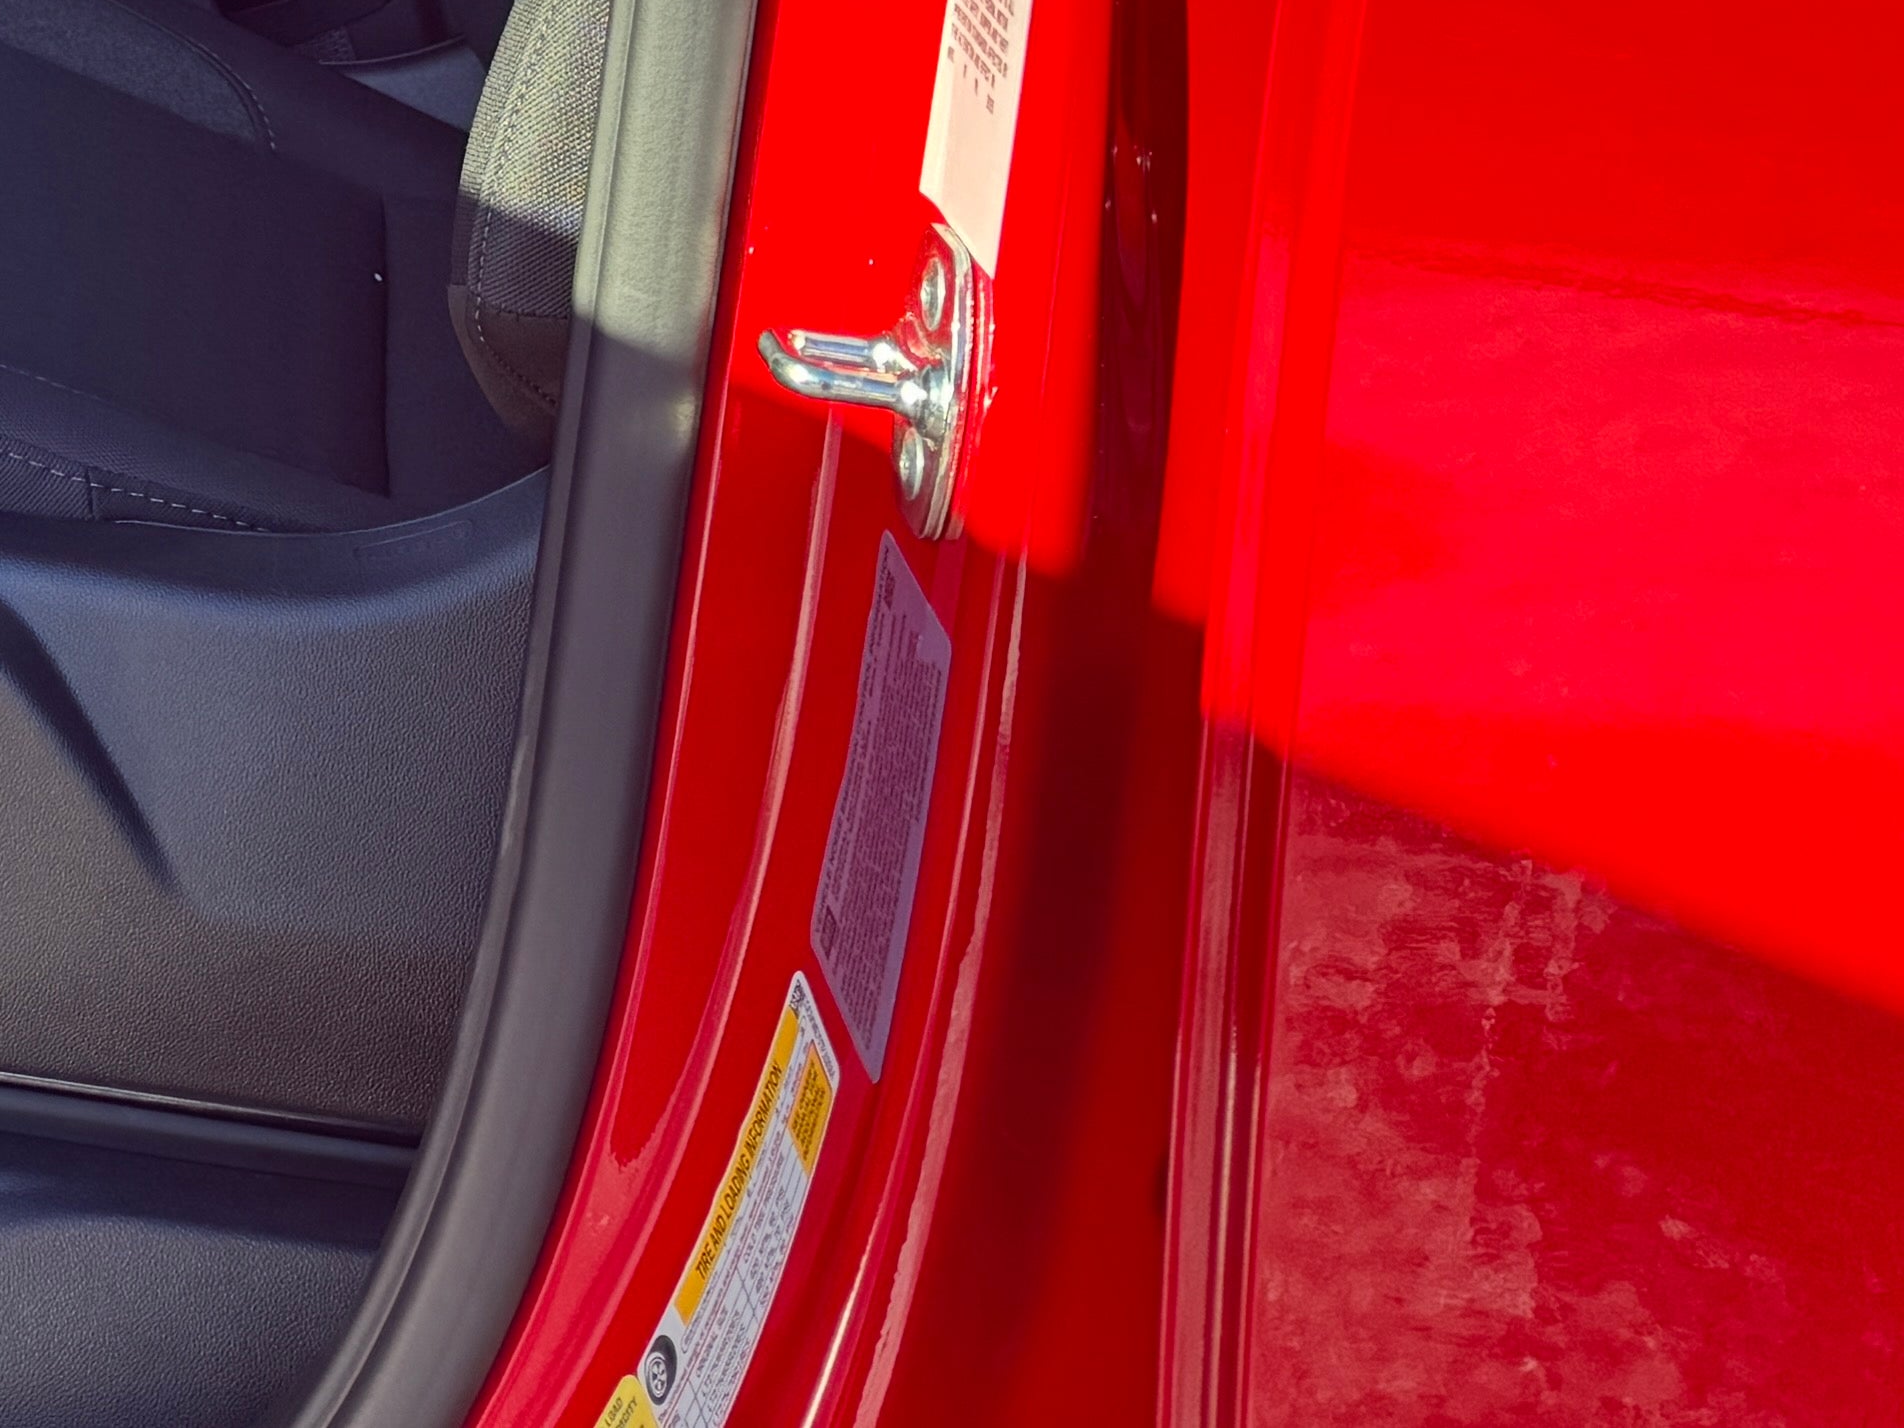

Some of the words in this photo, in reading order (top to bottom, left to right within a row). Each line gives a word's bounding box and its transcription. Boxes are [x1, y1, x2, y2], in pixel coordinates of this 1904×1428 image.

[695, 1243, 713, 1281] TIRE
[709, 1214, 726, 1254] AND
[721, 1153, 752, 1218] LOADING
[744, 1060, 783, 1161] INFORMATION
